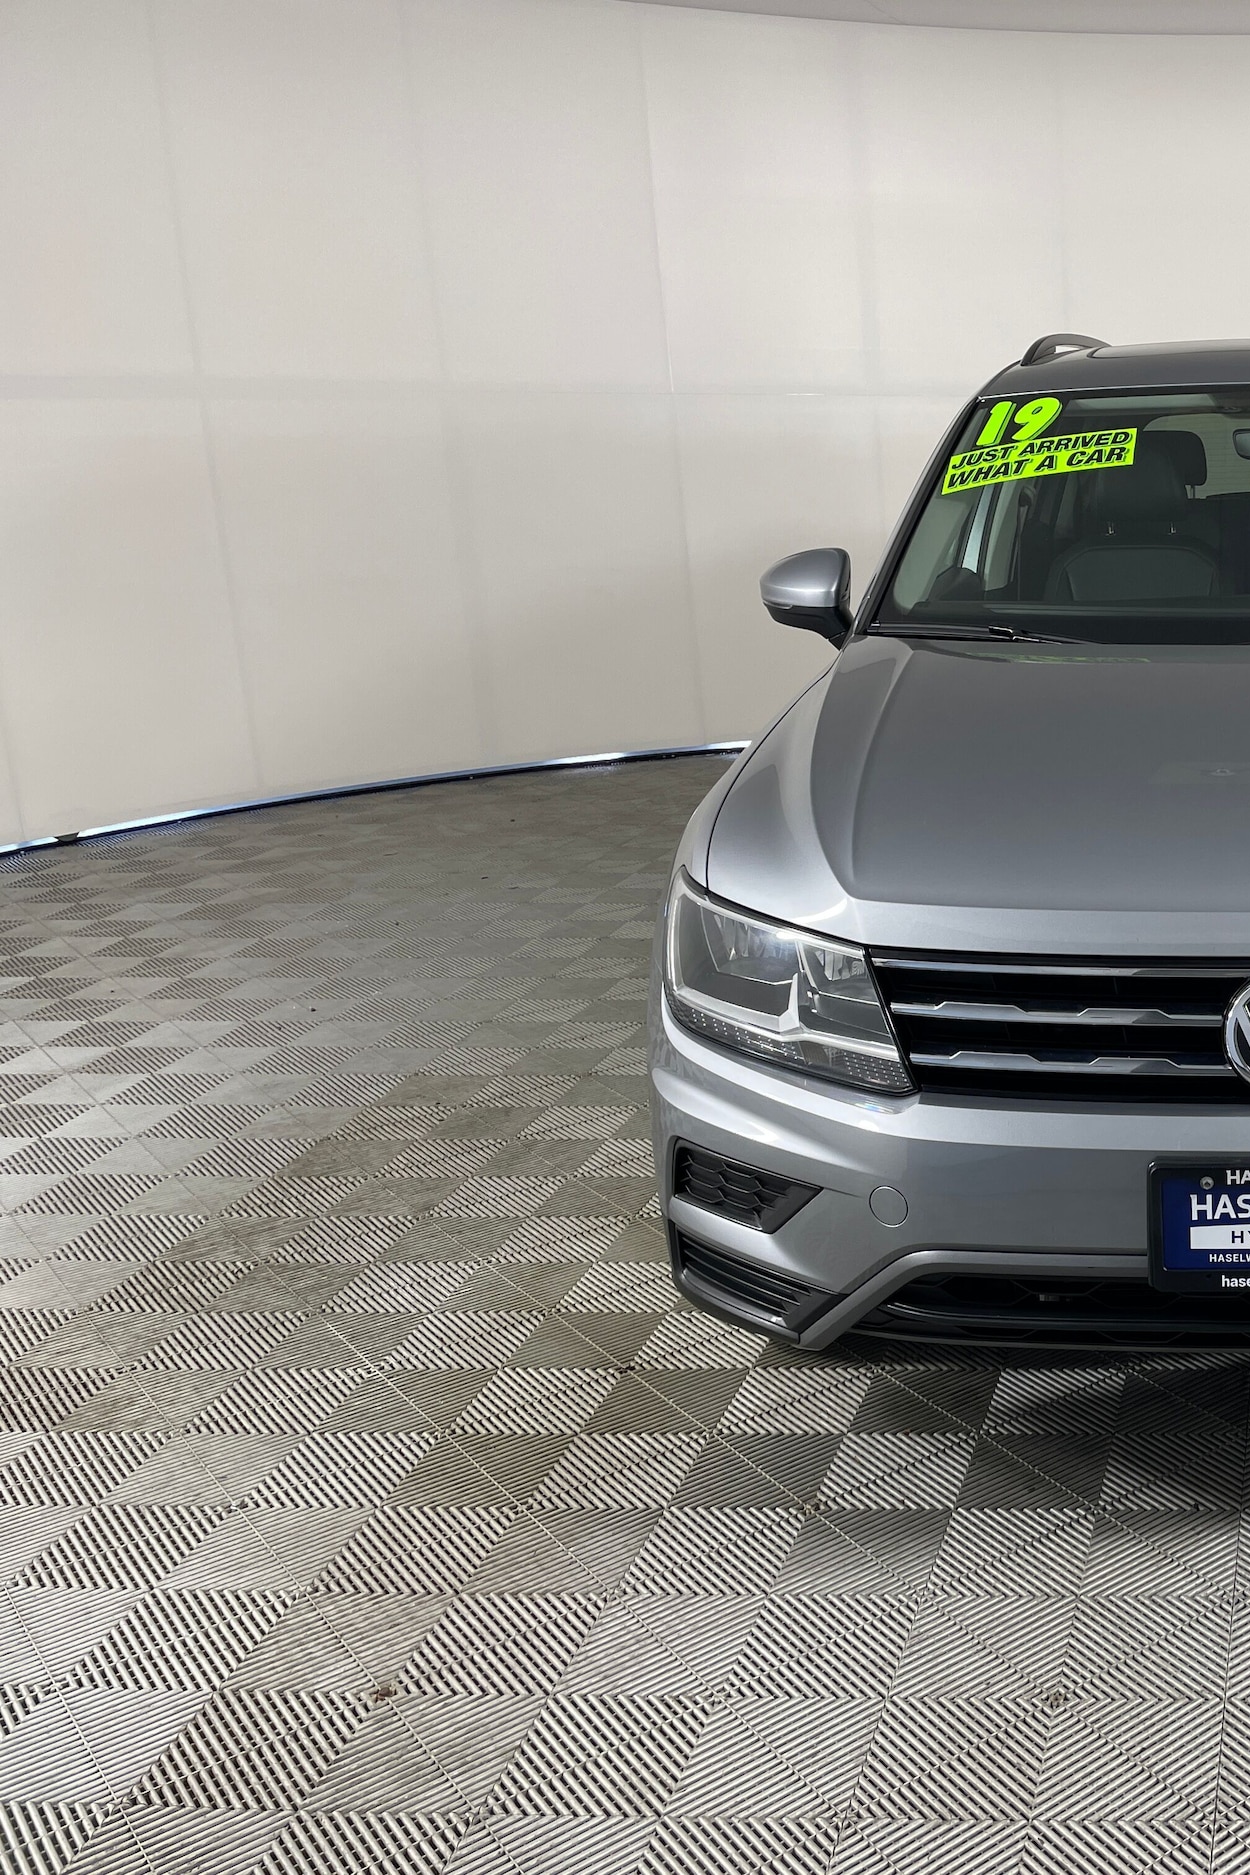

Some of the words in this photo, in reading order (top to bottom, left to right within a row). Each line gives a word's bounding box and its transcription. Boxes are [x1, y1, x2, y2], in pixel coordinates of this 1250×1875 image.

[976, 397, 1063, 446] 19
[948, 459, 1029, 488] WHAT
[1035, 455, 1056, 471] A
[1066, 447, 1127, 467] CAR
[951, 446, 1016, 470] JUST
[1019, 431, 1131, 457] ARRIVED
